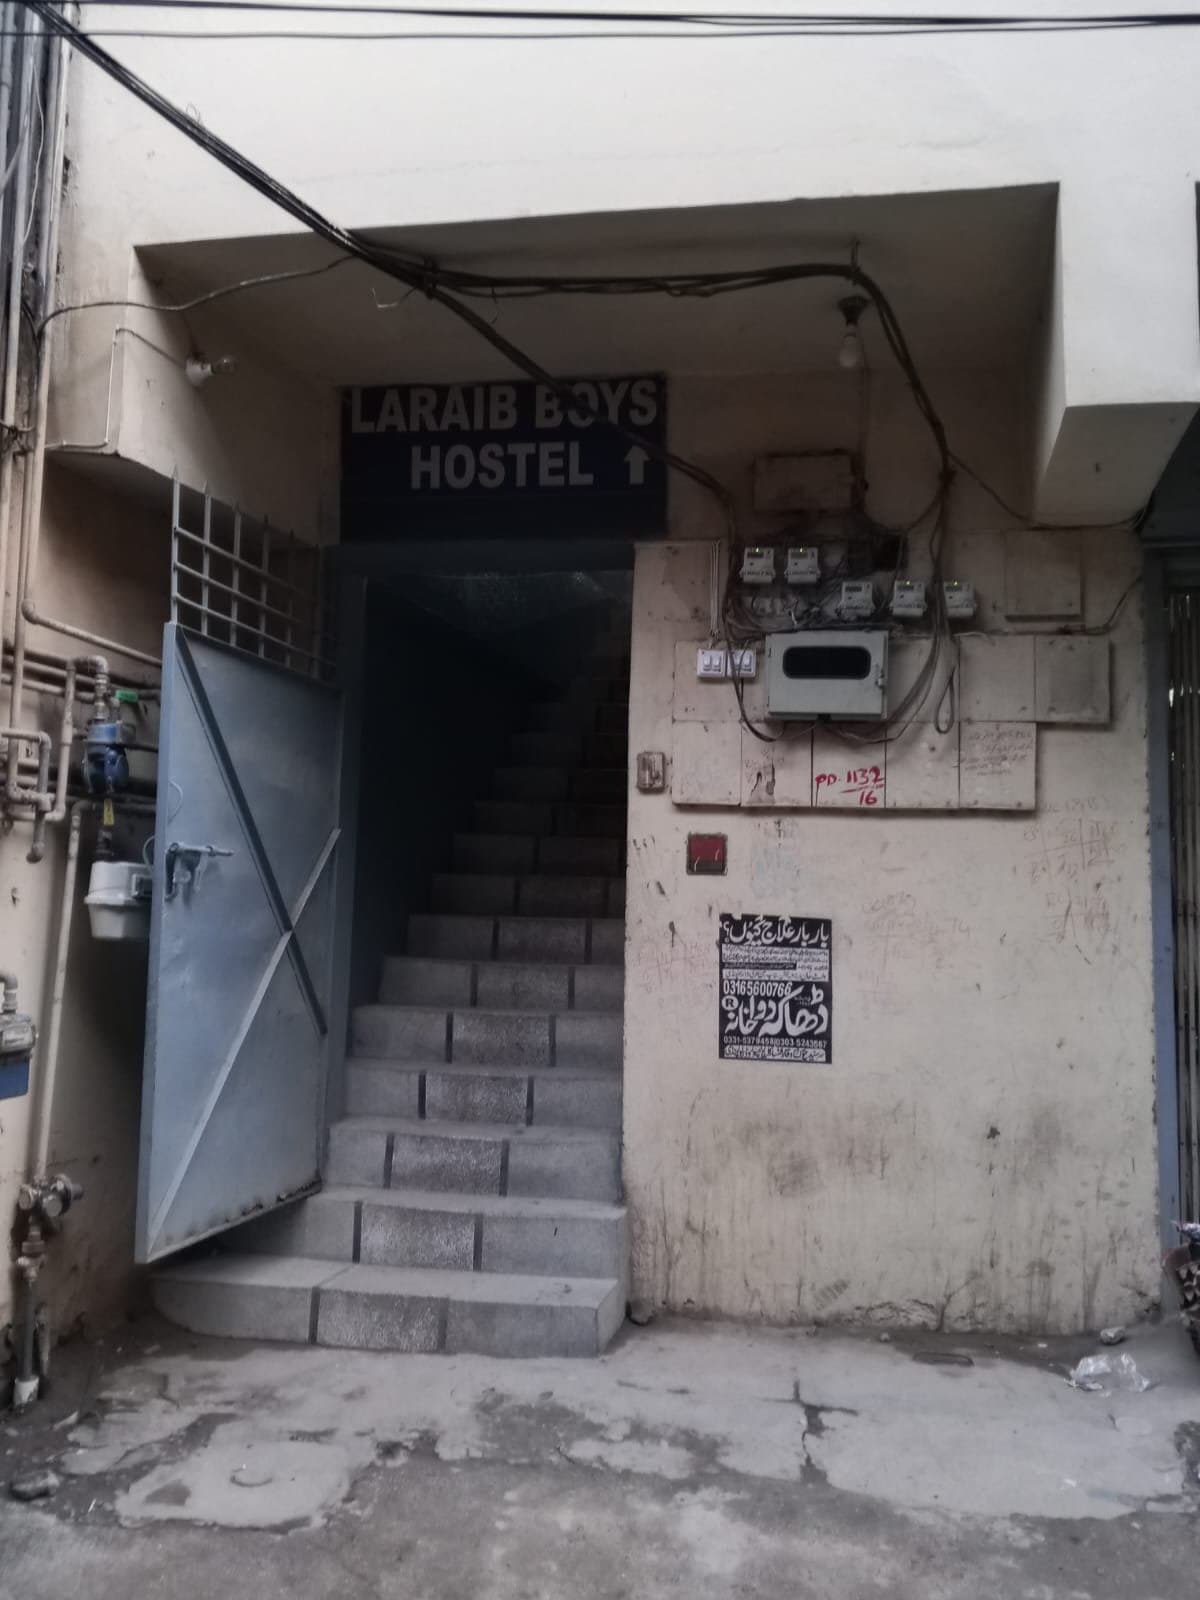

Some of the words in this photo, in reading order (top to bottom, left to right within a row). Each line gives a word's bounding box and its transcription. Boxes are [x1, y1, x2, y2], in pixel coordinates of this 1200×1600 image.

[351, 384, 517, 433] LARAIB
[535, 379, 657, 429] BOYS
[410, 440, 595, 489] HOSTEL
[847, 766, 885, 785] 1132
[859, 790, 878, 806] 16
[789, 921, 810, 947] بار
[808, 922, 830, 948] بار
[723, 979, 793, 998] 03165600766
